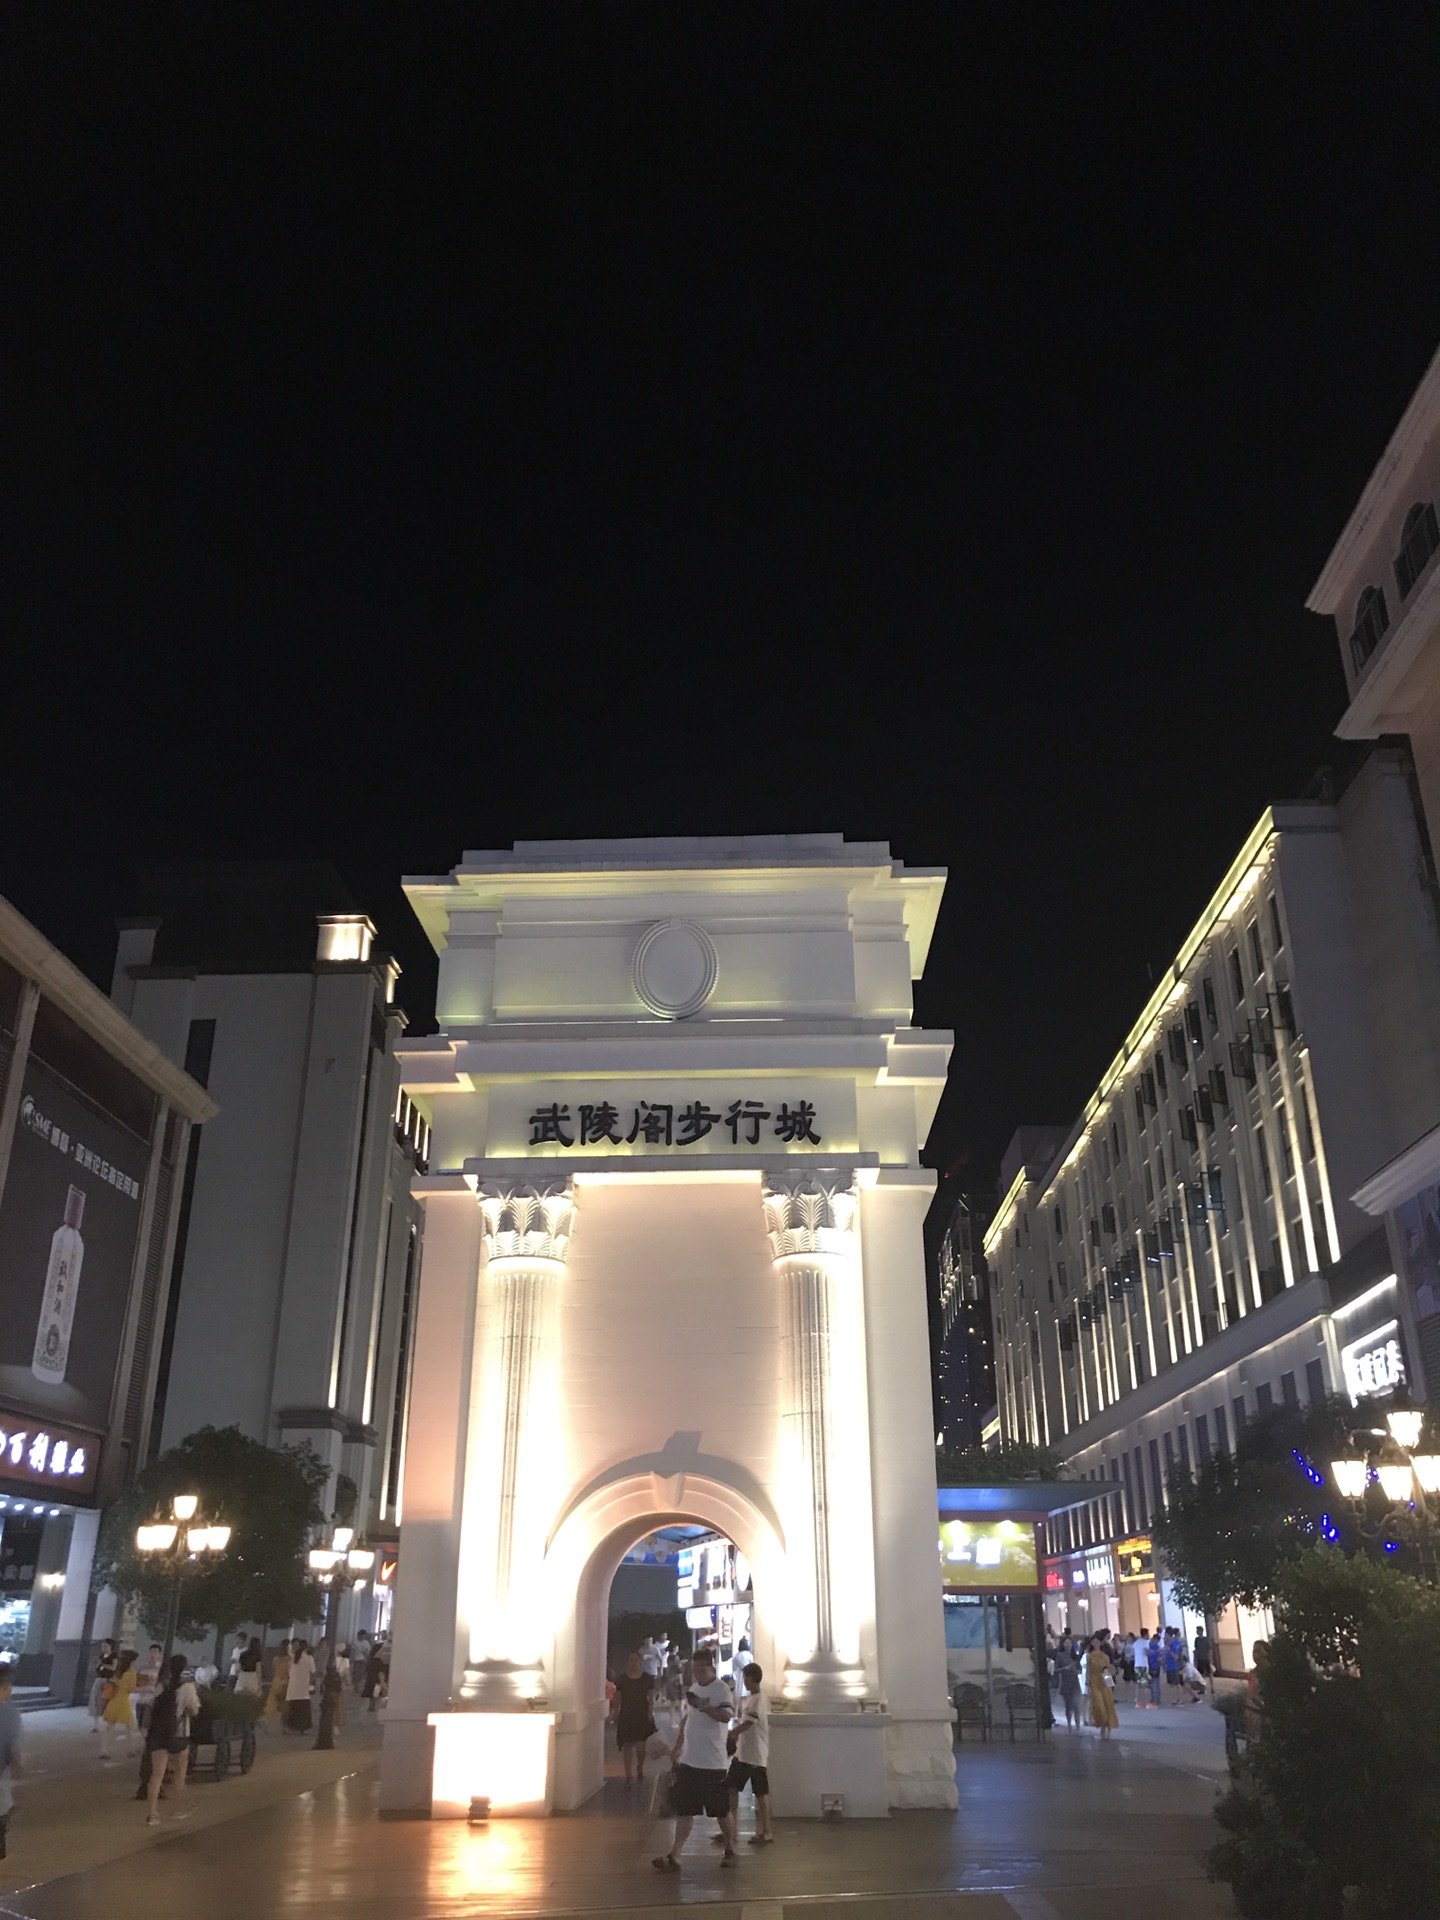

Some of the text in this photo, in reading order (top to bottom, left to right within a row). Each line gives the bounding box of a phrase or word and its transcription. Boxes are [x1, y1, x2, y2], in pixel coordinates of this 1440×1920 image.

[528, 1099, 822, 1147] 武陵阁步行城
